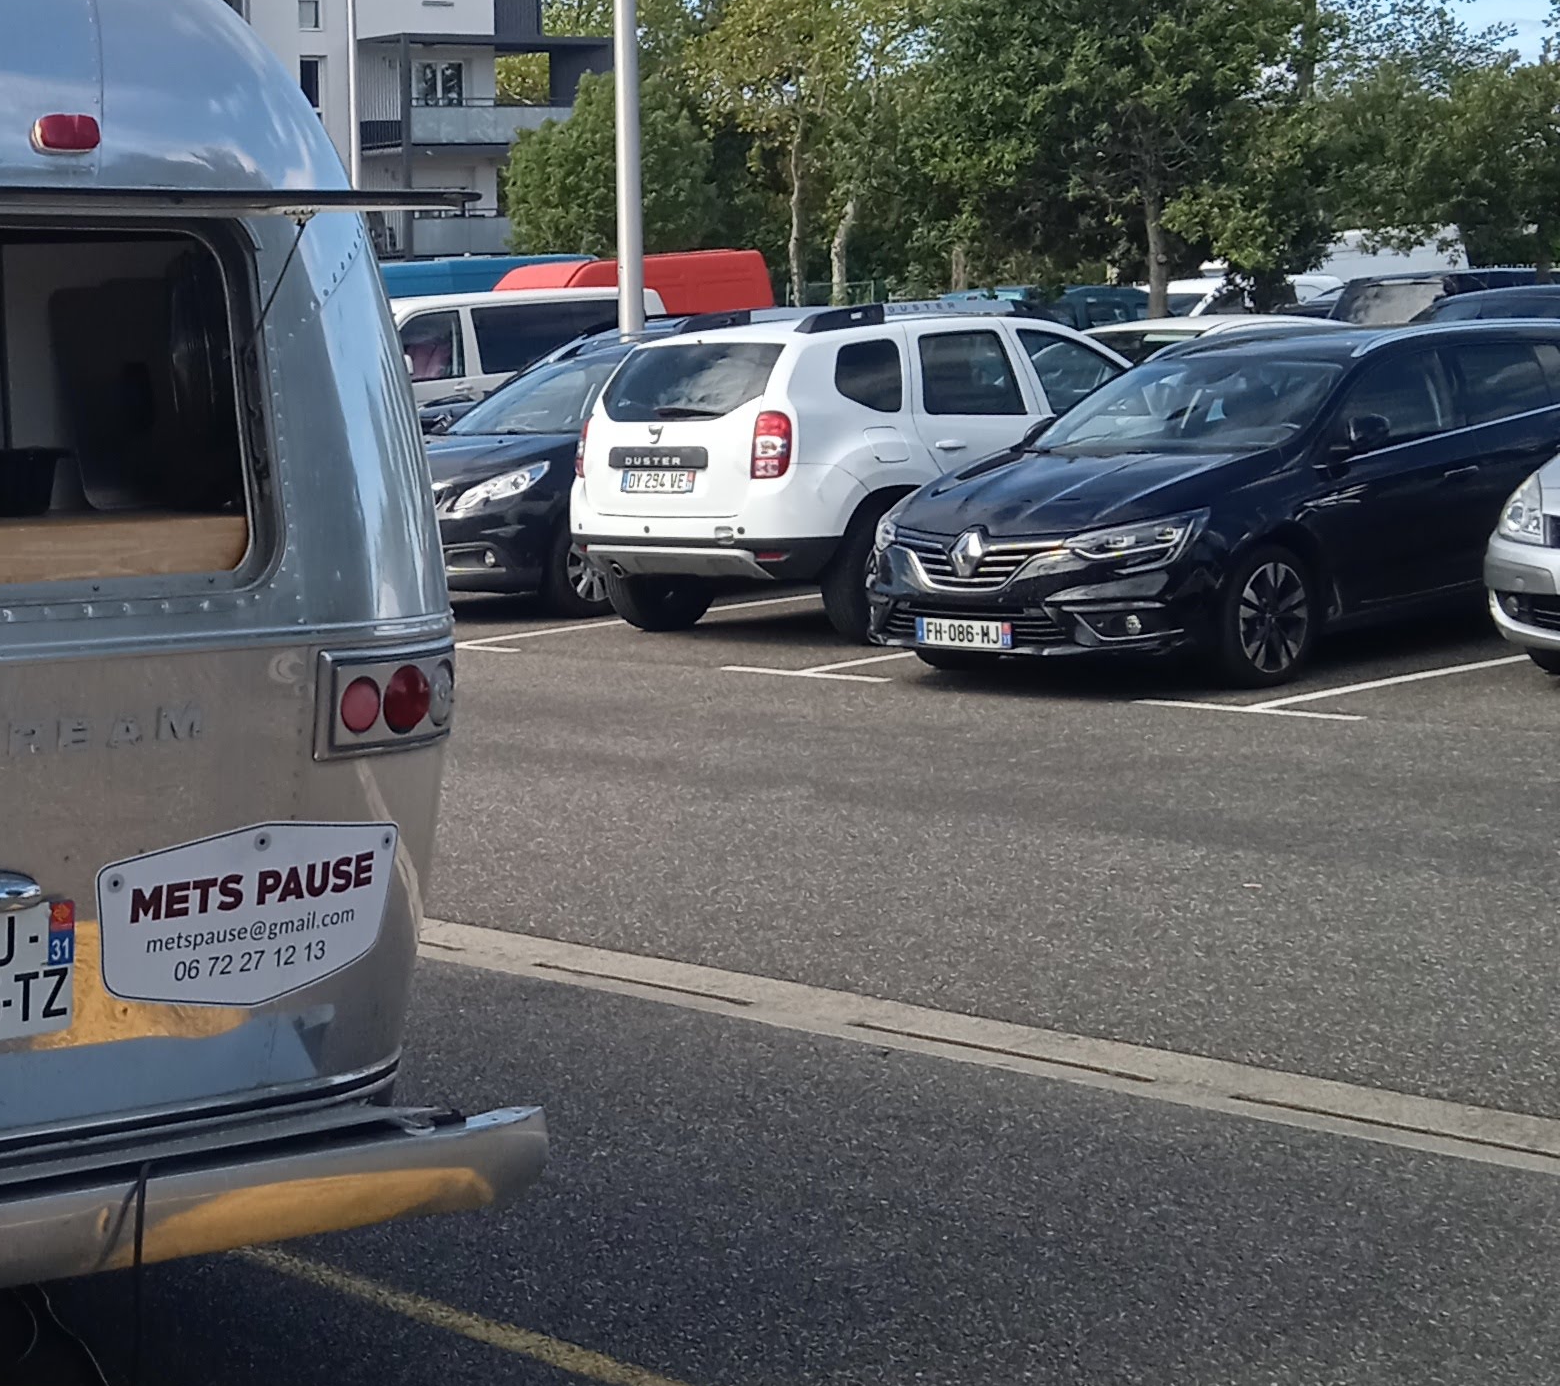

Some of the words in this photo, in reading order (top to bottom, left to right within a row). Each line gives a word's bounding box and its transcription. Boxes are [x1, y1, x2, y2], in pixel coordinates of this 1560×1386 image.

[887, 301, 956, 312] DUSTER
[624, 456, 682, 466] DUSTER
[129, 874, 244, 924] METS
[256, 850, 375, 906] PAUSE
[145, 908, 355, 954] metspause@gmail.com
[51, 937, 70, 960] 31
[173, 961, 200, 982] 06
[208, 955, 232, 977] 72
[239, 950, 265, 973] 27
[273, 945, 297, 968] 12
[304, 940, 326, 962] 13
